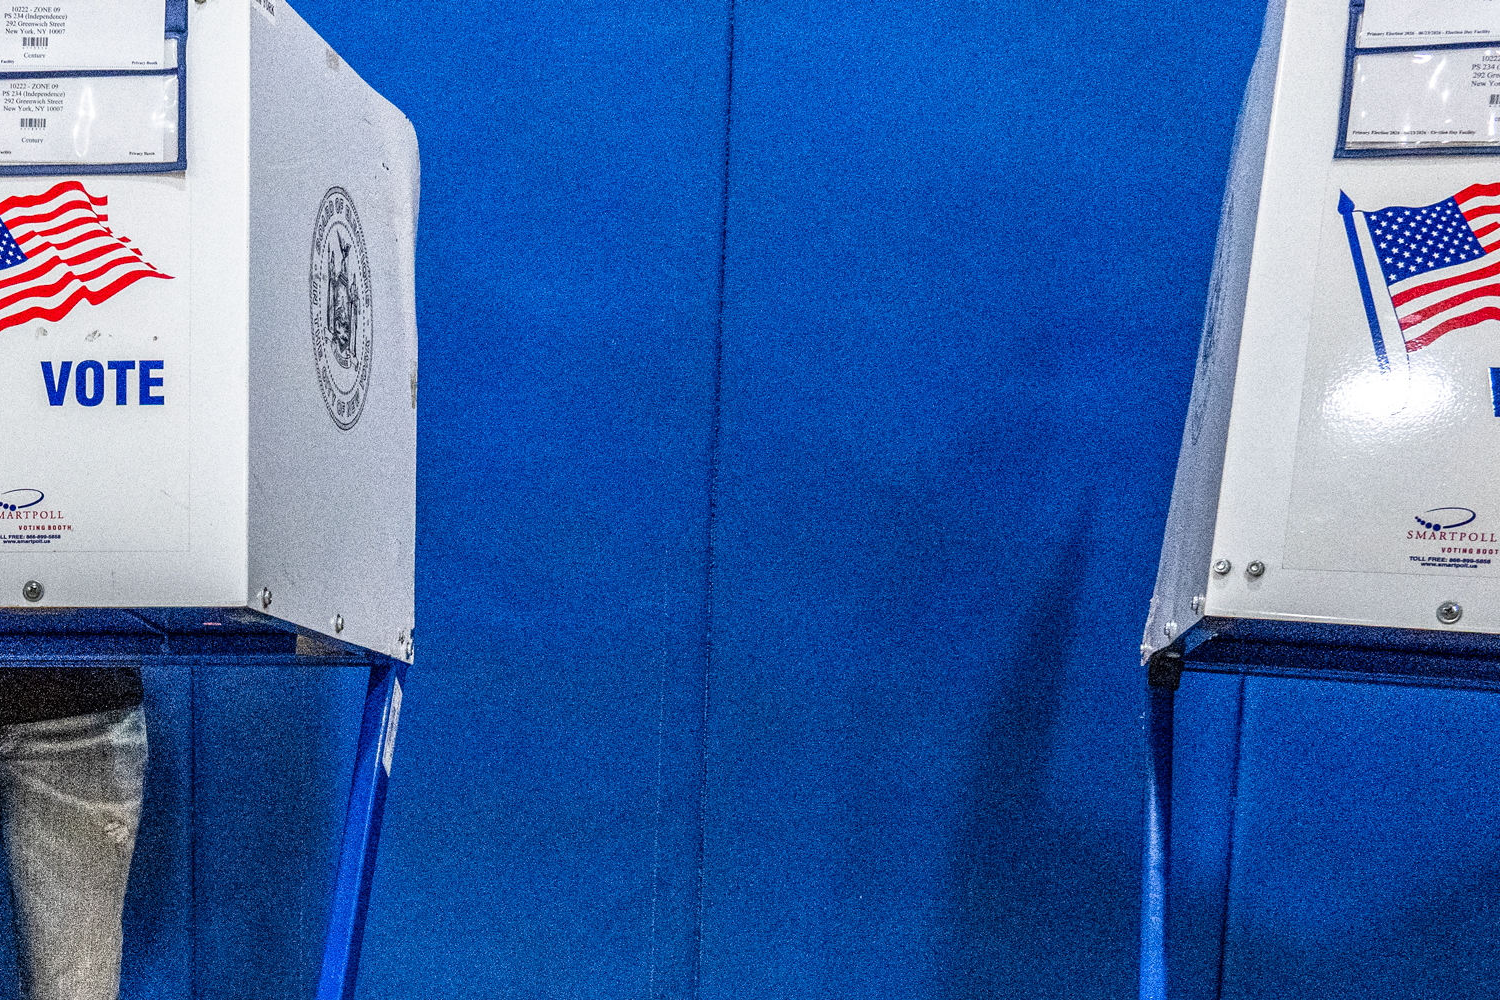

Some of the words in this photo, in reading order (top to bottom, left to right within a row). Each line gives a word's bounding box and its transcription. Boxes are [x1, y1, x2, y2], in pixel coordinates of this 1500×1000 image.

[23, 90, 66, 98] (Independence)
[40, 360, 165, 407] VOTE
[1406, 530, 1498, 543] SMARTPOLL
